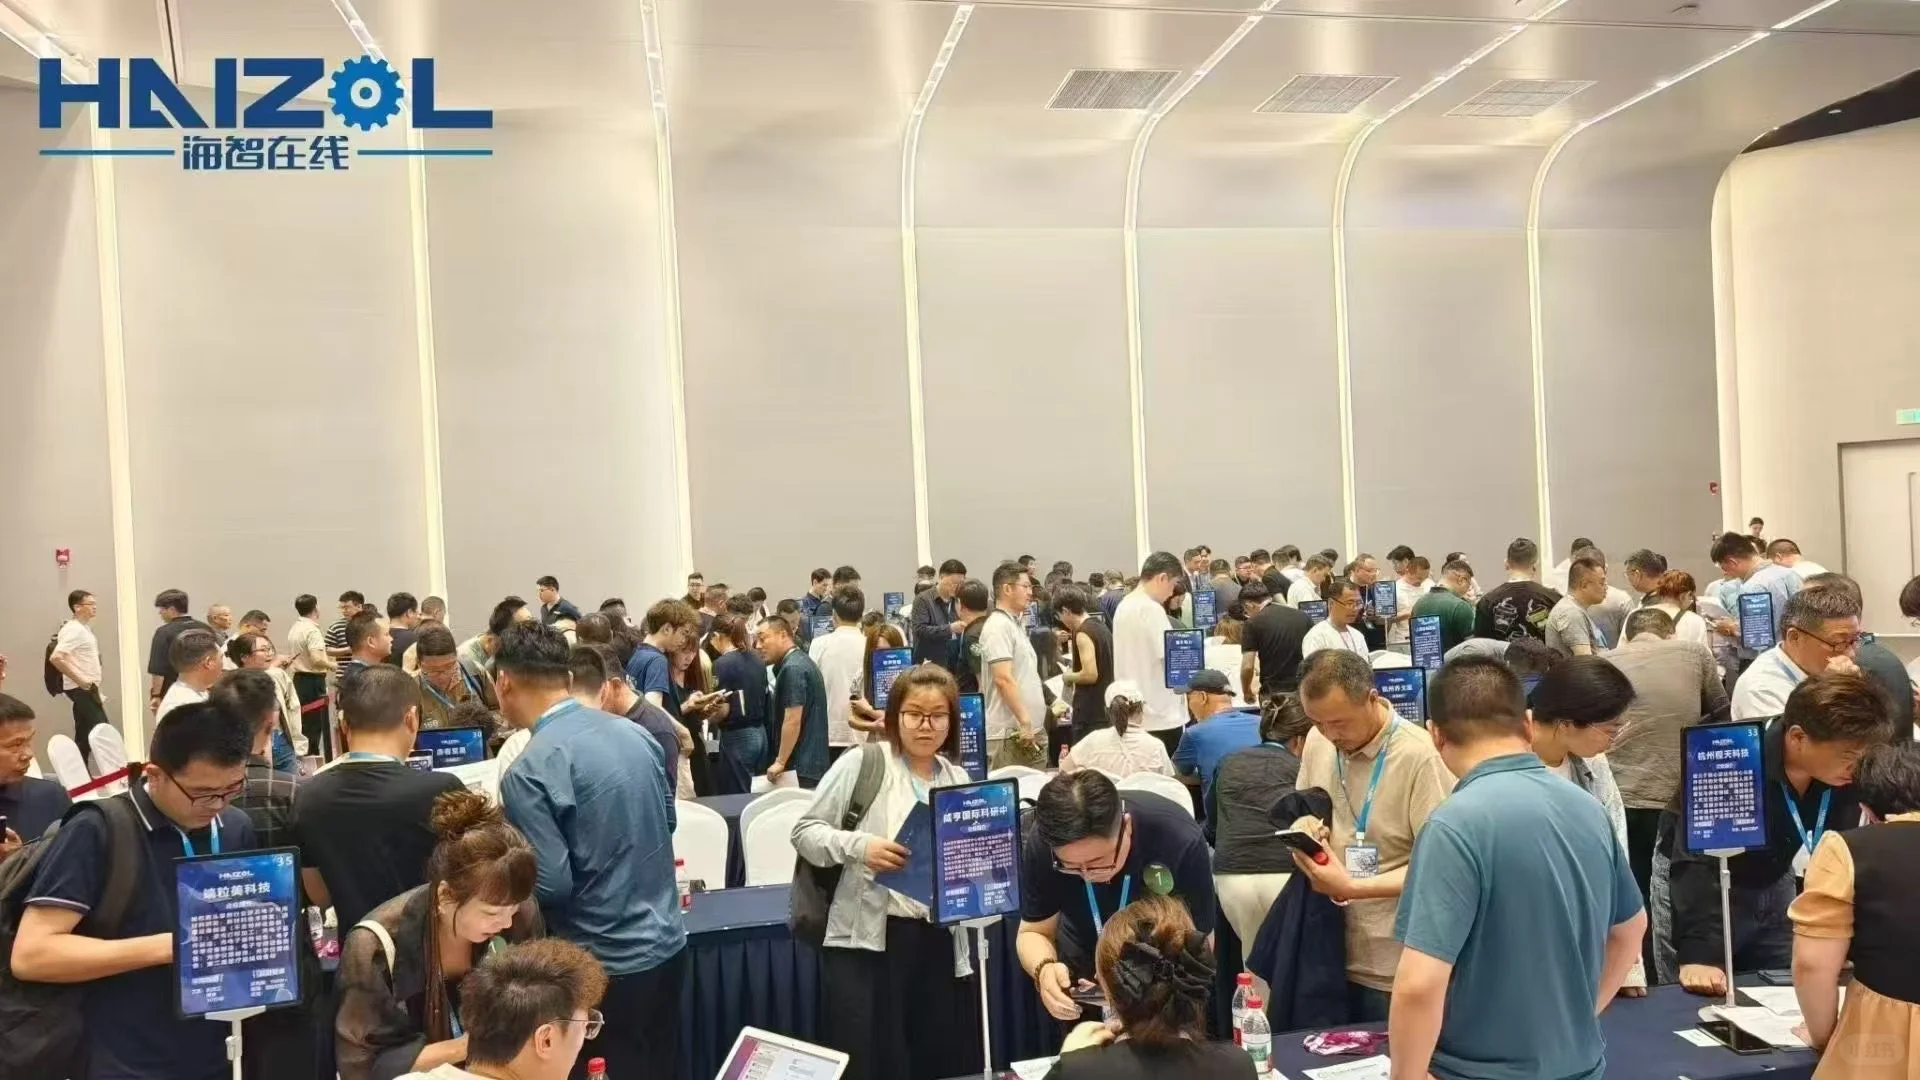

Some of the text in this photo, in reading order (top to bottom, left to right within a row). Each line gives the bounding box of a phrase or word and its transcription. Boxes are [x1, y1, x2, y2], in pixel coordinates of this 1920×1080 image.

[1747, 728, 1758, 737] 33
[943, 805, 1008, 823] 咸亨国际科研中
